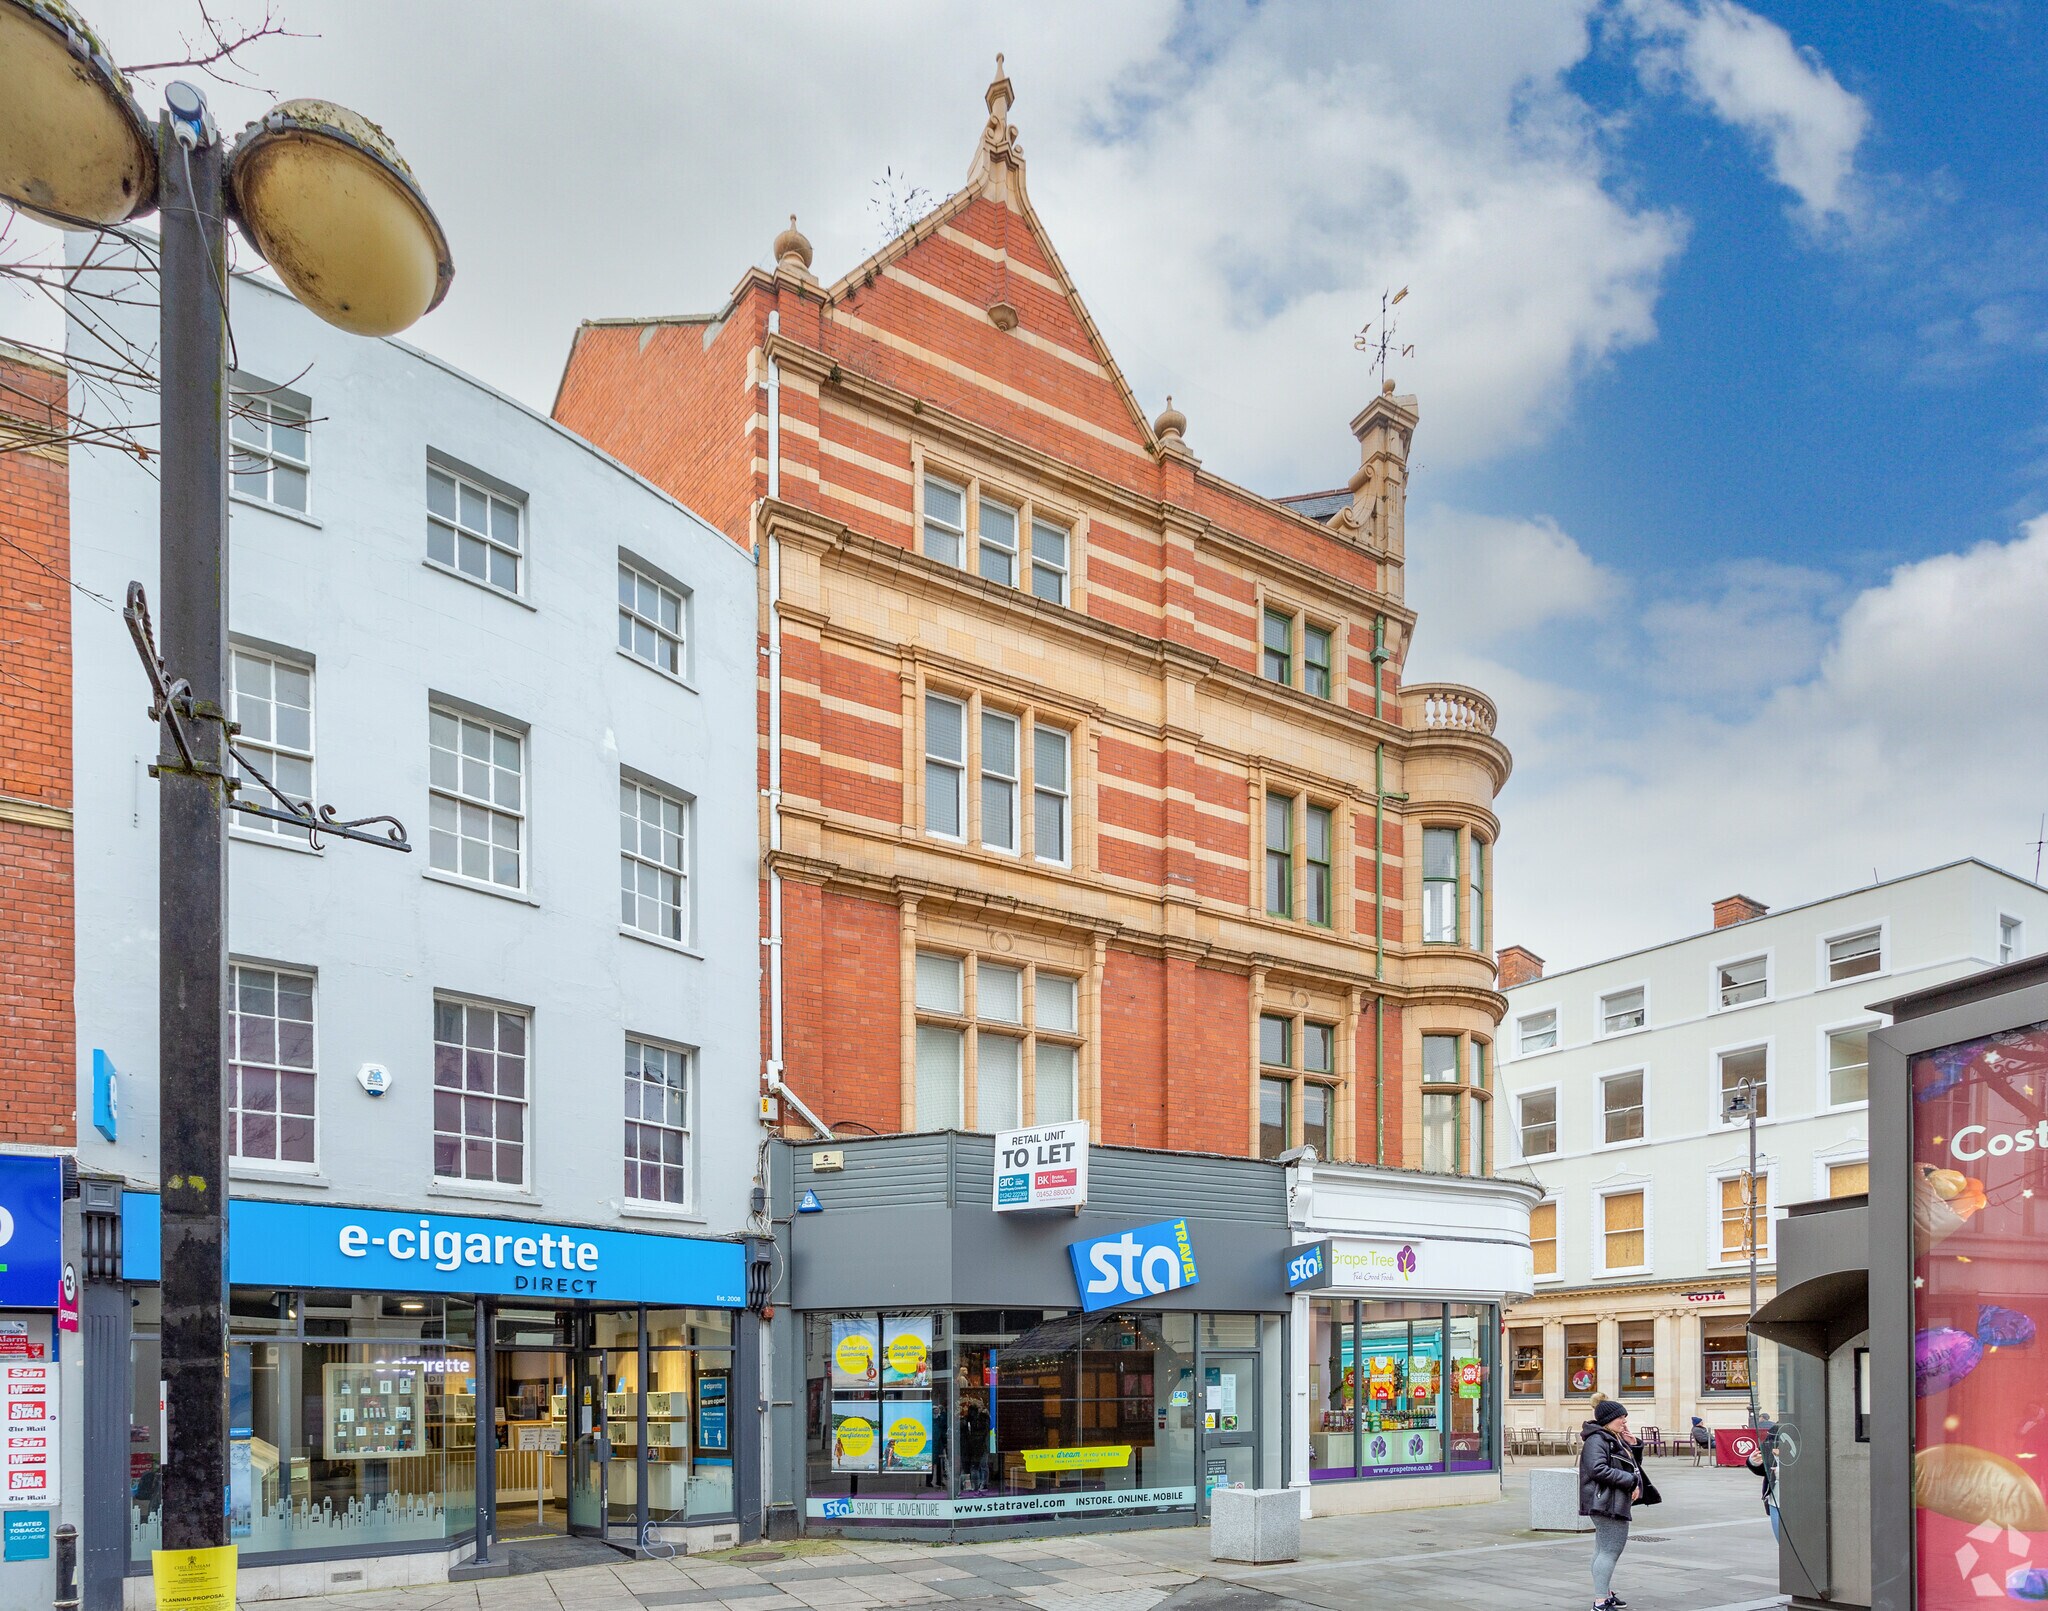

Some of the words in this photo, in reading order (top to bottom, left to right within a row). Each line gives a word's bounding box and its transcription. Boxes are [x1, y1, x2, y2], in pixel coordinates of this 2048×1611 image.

[1012, 1134, 1041, 1145] RETAIL
[1045, 1130, 1065, 1141] UNIT
[1951, 1120, 2048, 1161] Cost
[1002, 1148, 1029, 1169] TO
[1037, 1142, 1075, 1165] LET
[1000, 1177, 1014, 1187] arc
[1037, 1175, 1049, 1185] BK
[339, 1219, 599, 1272] e-cigarette
[1173, 1220, 1197, 1283] TRAVEL
[1087, 1232, 1180, 1295] sta
[1332, 1249, 1368, 1269] Grape
[1369, 1251, 1395, 1267] Tree
[1290, 1255, 1318, 1281] sta
[1353, 1271, 1363, 1281] Feel
[1364, 1272, 1380, 1281] Good
[1380, 1272, 1394, 1281] Foods
[515, 1275, 598, 1294] DIRECT
[10, 1368, 43, 1377] Sun
[10, 1385, 45, 1395] Mirror
[11, 1438, 44, 1447] Sun
[11, 1454, 45, 1464] Mirror
[1373, 1464, 1433, 1473] www.grapetree.co.uk
[954, 1498, 1065, 1514] www.statravel.com
[1075, 1496, 1116, 1507] INSTORE.
[1118, 1493, 1151, 1504] ONLINE.
[1153, 1491, 1183, 1501] MOBILE
[826, 1501, 849, 1516] sta
[856, 1503, 877, 1515] START
[882, 1503, 894, 1515] THE
[897, 1503, 940, 1516] ADVENTURE
[192, 1593, 225, 1602] PROPOSAL
